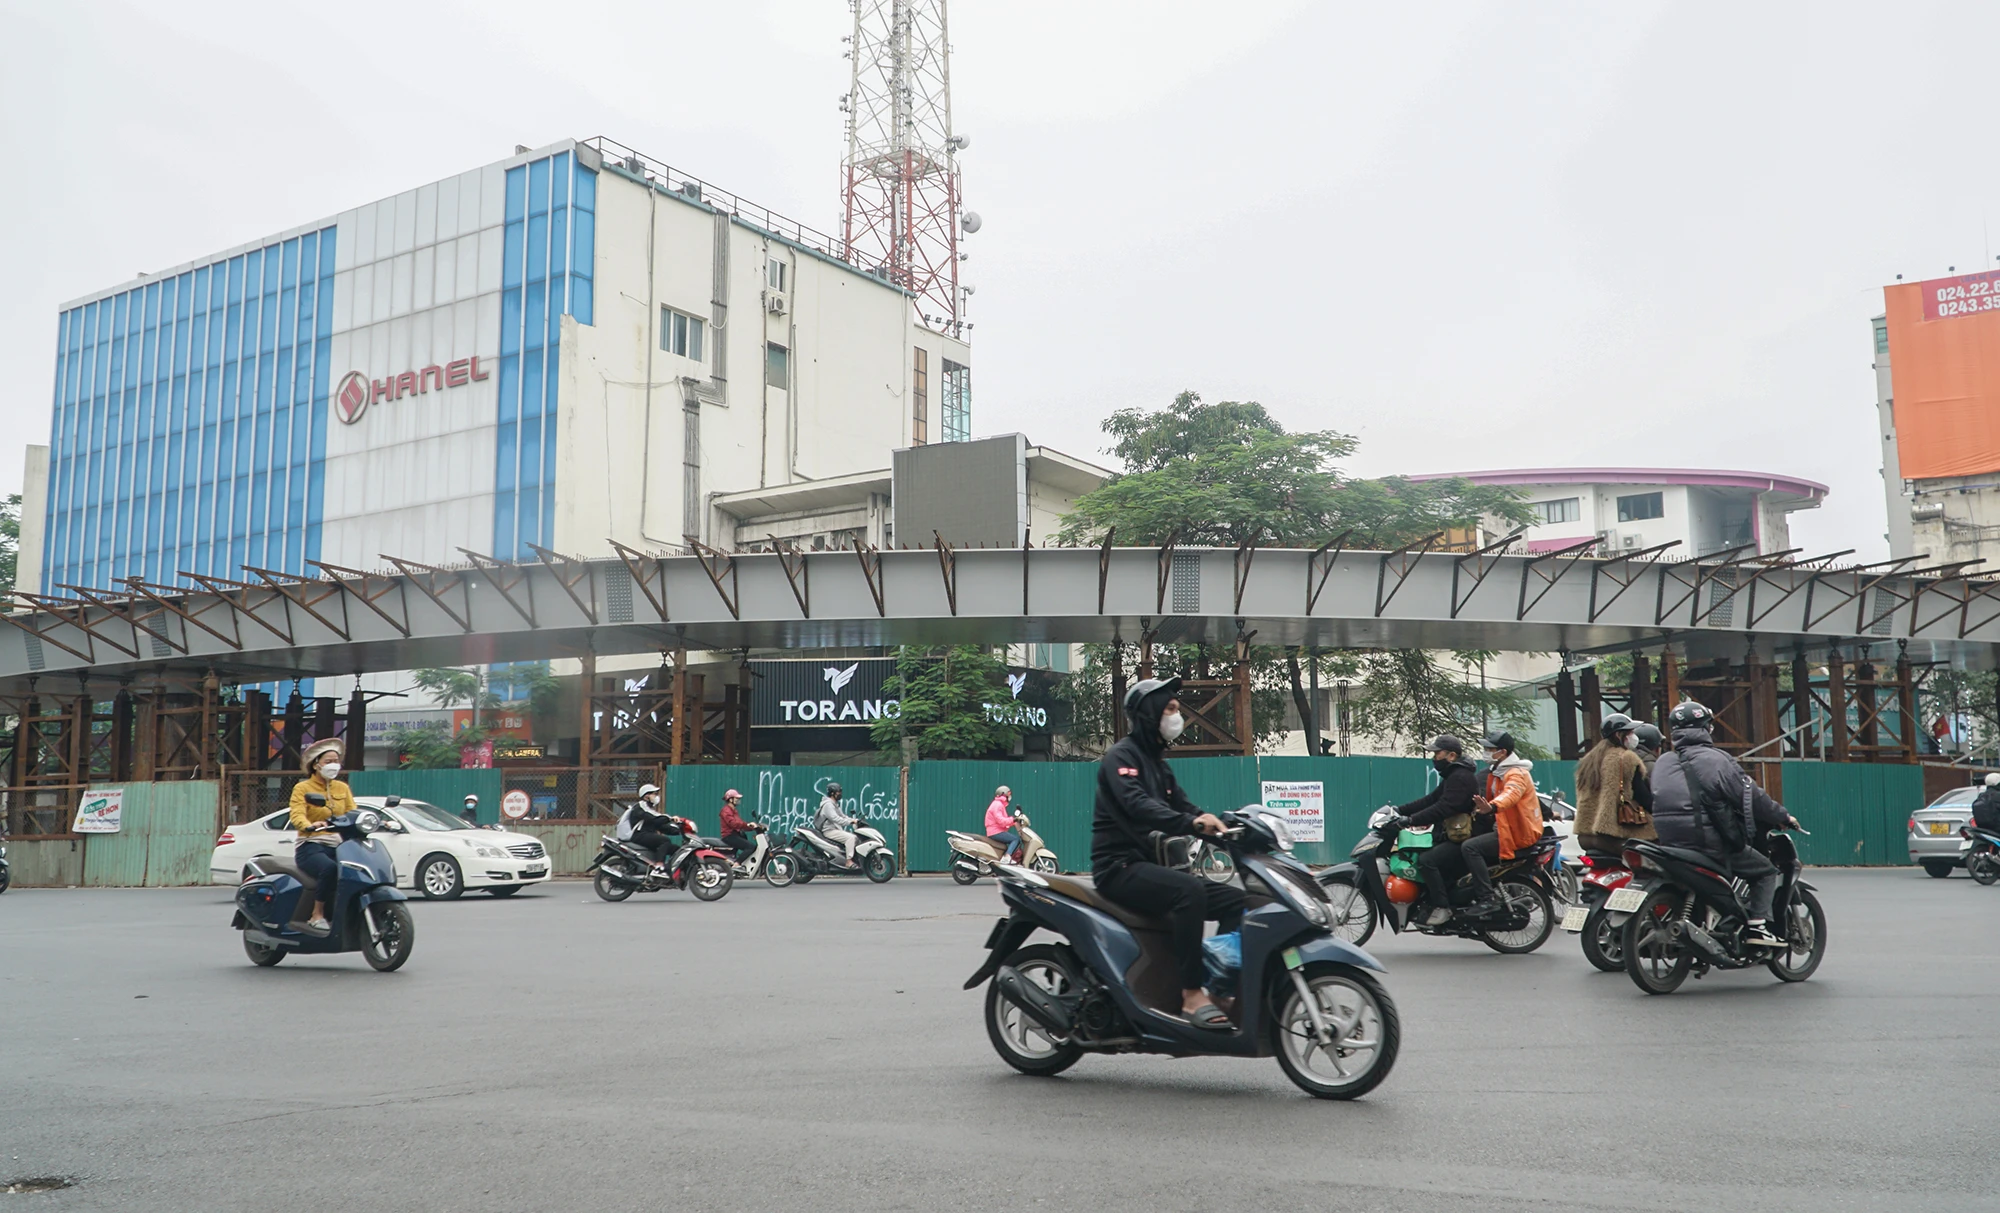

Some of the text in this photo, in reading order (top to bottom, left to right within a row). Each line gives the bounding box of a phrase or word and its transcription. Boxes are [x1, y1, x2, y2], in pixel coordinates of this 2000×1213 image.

[1936, 279, 2000, 302] 024.22.6
[1938, 295, 2000, 317] 0243.35
[371, 355, 489, 405] HANEL
[780, 699, 902, 721] TORANO
[758, 770, 807, 817] Mua
